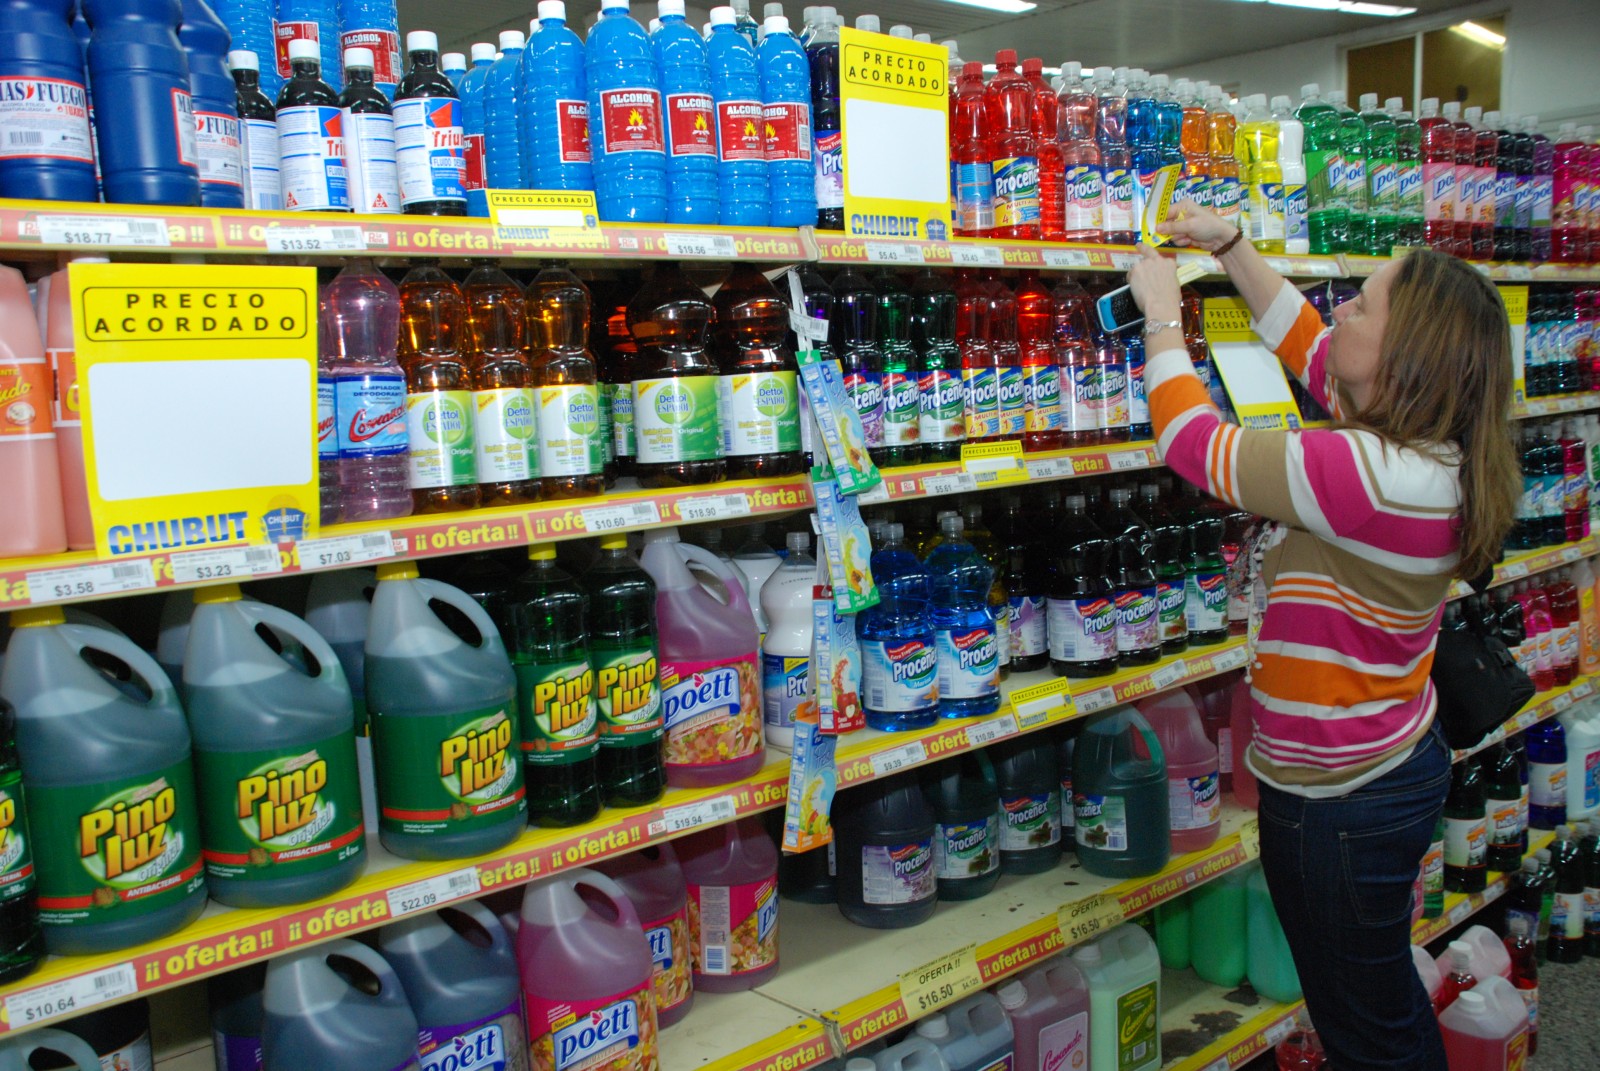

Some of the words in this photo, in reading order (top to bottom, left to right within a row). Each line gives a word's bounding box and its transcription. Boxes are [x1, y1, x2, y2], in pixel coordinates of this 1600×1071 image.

[344, 34, 381, 45] ALCOHOL
[863, 51, 926, 72] PRECIO
[848, 66, 939, 90] ACORDADO
[37, 83, 85, 107] FUEGO
[610, 94, 655, 104] ALCOHOL
[727, 106, 763, 116] ALCOHO
[764, 107, 788, 116] OHOL
[496, 196, 533, 204] PRECIO
[537, 196, 589, 204] ACORDADO
[1066, 181, 1101, 202] Procen
[851, 213, 919, 237] CHUBUT
[64, 231, 112, 245] $18.77
[281, 239, 321, 251] $13.52
[677, 244, 706, 255] $19.56
[126, 293, 265, 310] PRECIO
[95, 315, 296, 333] ACORDADO
[1209, 310, 1248, 318] PRECIO
[1206, 321, 1251, 329] ACORDA
[659, 393, 687, 405] Dettol
[759, 388, 784, 397] Dettol
[920, 384, 965, 413] Procene
[964, 377, 998, 407] Procen
[1024, 377, 1060, 405] Procen
[428, 410, 459, 422] Dettol
[507, 407, 530, 417] Dettol
[569, 403, 594, 414] Dettol
[679, 427, 704, 435] Original
[267, 514, 300, 525] CHUBUT
[689, 507, 717, 519] $18.90
[108, 511, 248, 555] CHUBUT
[595, 517, 626, 530] $10.60
[319, 551, 351, 565] $7.03
[196, 565, 232, 578] $3.23
[55, 582, 95, 597] $3.58
[1084, 608, 1115, 636] Procen
[598, 657, 657, 699] Pino
[534, 669, 593, 717] Pino
[612, 681, 653, 717] luz
[663, 672, 733, 727] poett
[550, 694, 588, 734] luz
[441, 719, 512, 777] Pino
[460, 749, 507, 797] luz
[884, 759, 902, 771] $9.39
[238, 759, 328, 819] Pino
[259, 793, 318, 842] luz
[1008, 800, 1048, 826] Procenex
[1077, 803, 1102, 817] rocenex
[81, 787, 175, 859] Pino
[675, 815, 703, 829] $19.94
[106, 823, 168, 880] luz
[278, 842, 332, 860] ANTIBACTERIAL
[948, 829, 987, 854] Procenex
[127, 875, 183, 898] ANTIBACTERIAL
[401, 892, 437, 912] $22.09
[1071, 899, 1101, 918] OFERTA
[1070, 919, 1101, 940] $16.50
[919, 962, 953, 985] OFERTA
[918, 983, 954, 1010] $16.50
[26, 994, 76, 1021] $10.64
[560, 1005, 631, 1064] poett
[424, 1029, 496, 1071] oett
